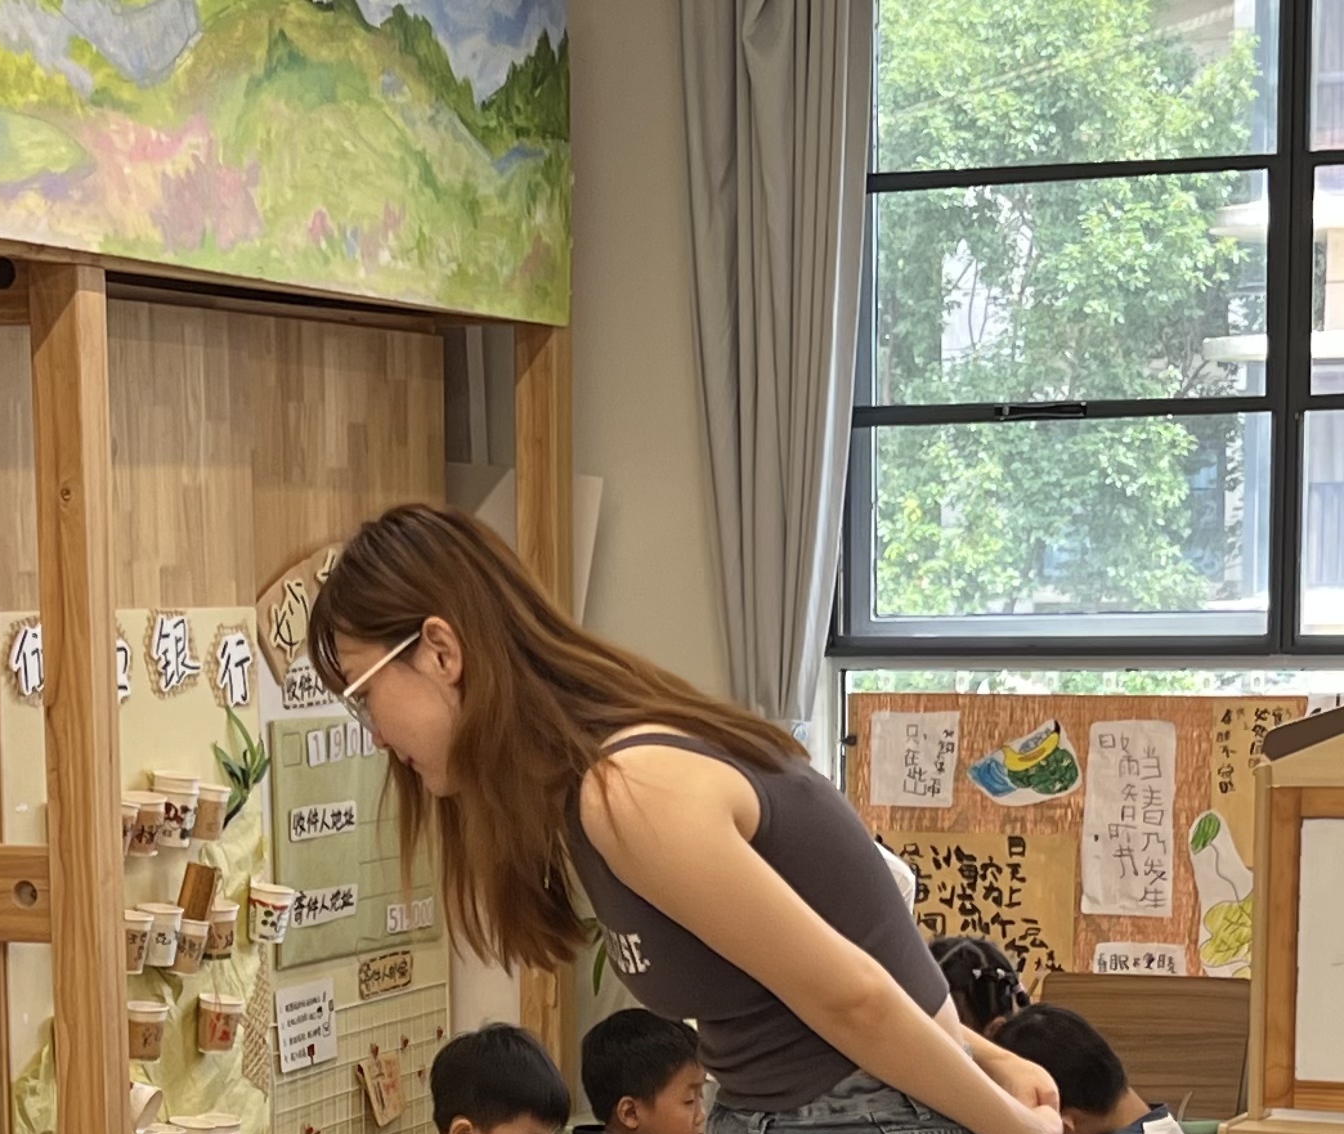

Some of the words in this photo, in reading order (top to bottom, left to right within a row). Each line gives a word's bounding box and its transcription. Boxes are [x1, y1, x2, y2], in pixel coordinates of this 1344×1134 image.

[293, 806, 356, 836] 收件人地址
[294, 887, 355, 926] 寄件人地址
